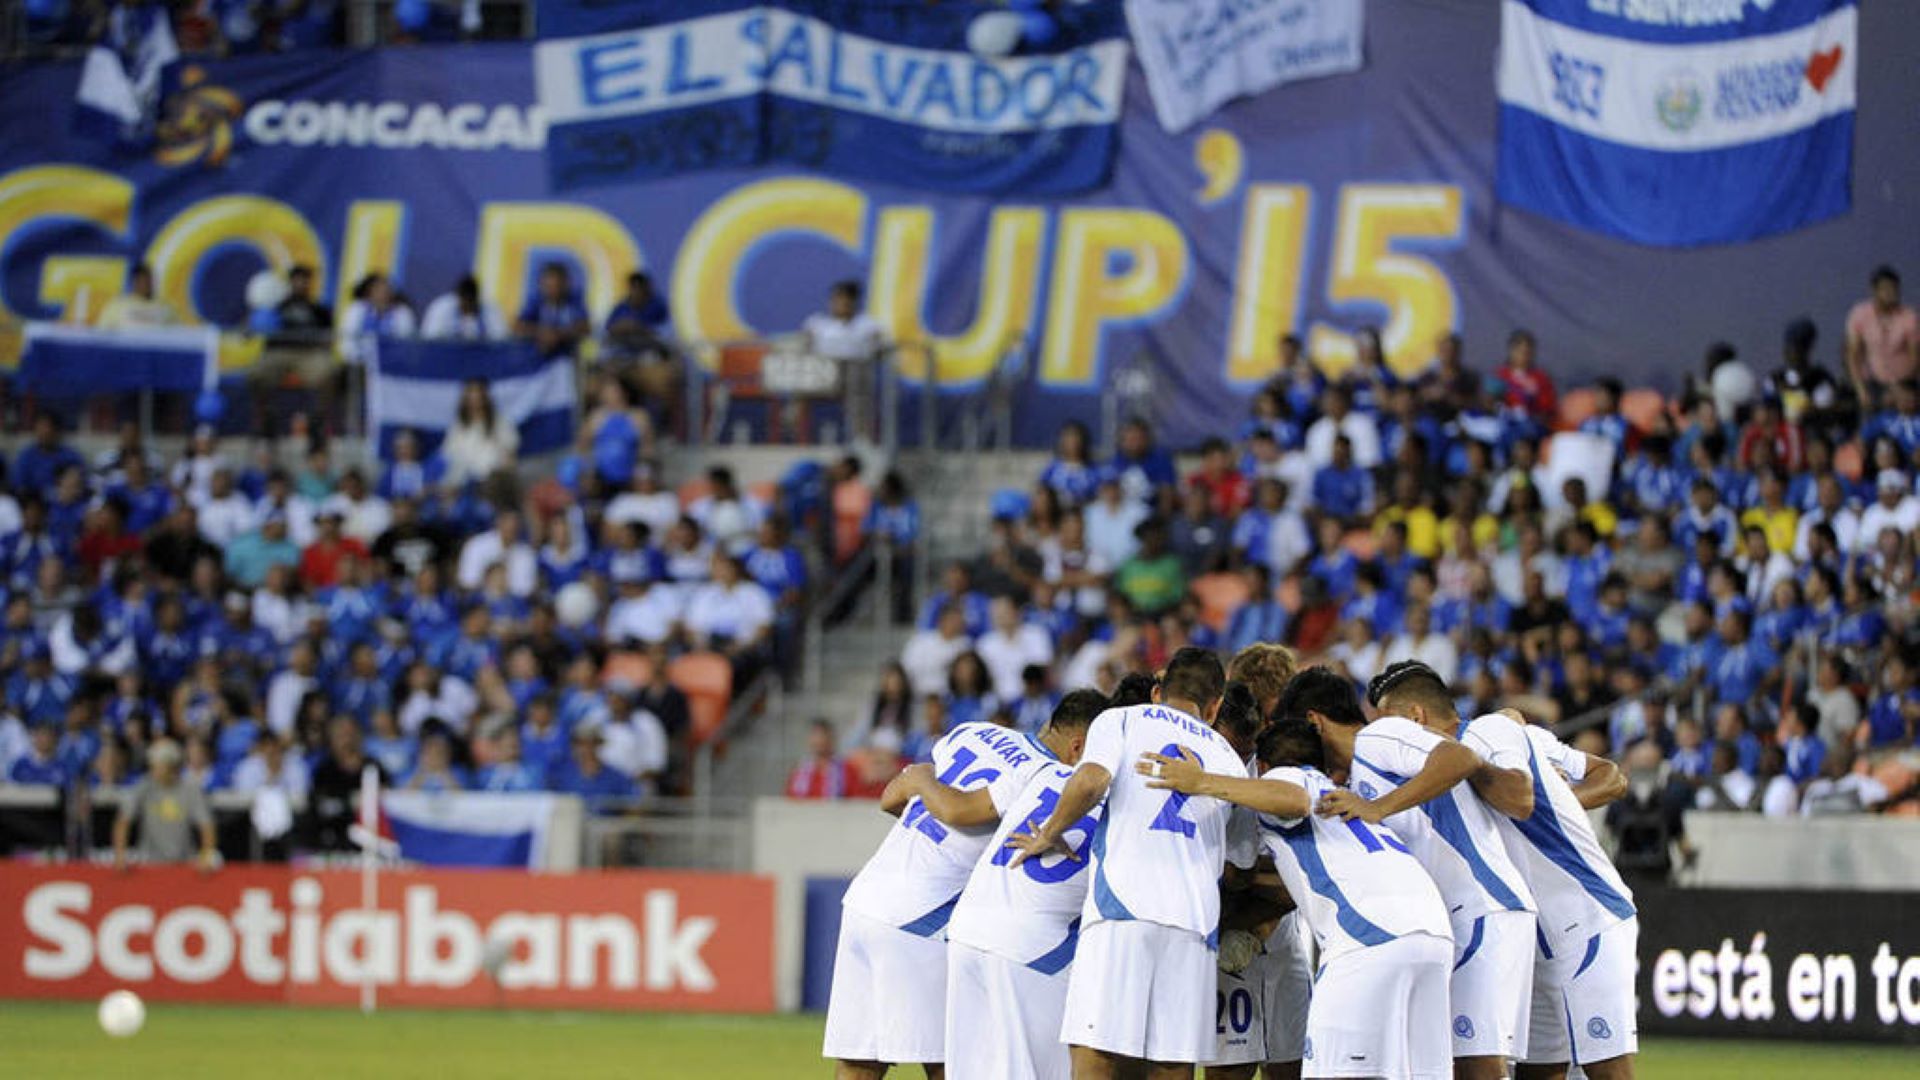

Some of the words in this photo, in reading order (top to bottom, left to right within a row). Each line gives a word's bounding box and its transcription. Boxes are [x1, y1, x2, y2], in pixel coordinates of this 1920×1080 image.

[578, 33, 723, 107] EL
[740, 12, 1106, 123] SALVADOR
[0, 164, 642, 372] GOLD
[670, 176, 1190, 390] CUP
[1142, 707, 1214, 740] XAVIER
[1148, 743, 1205, 839] 2
[23, 877, 719, 992] Scotiabank
[1653, 931, 1776, 1020] está
[1787, 953, 1857, 1022] en
